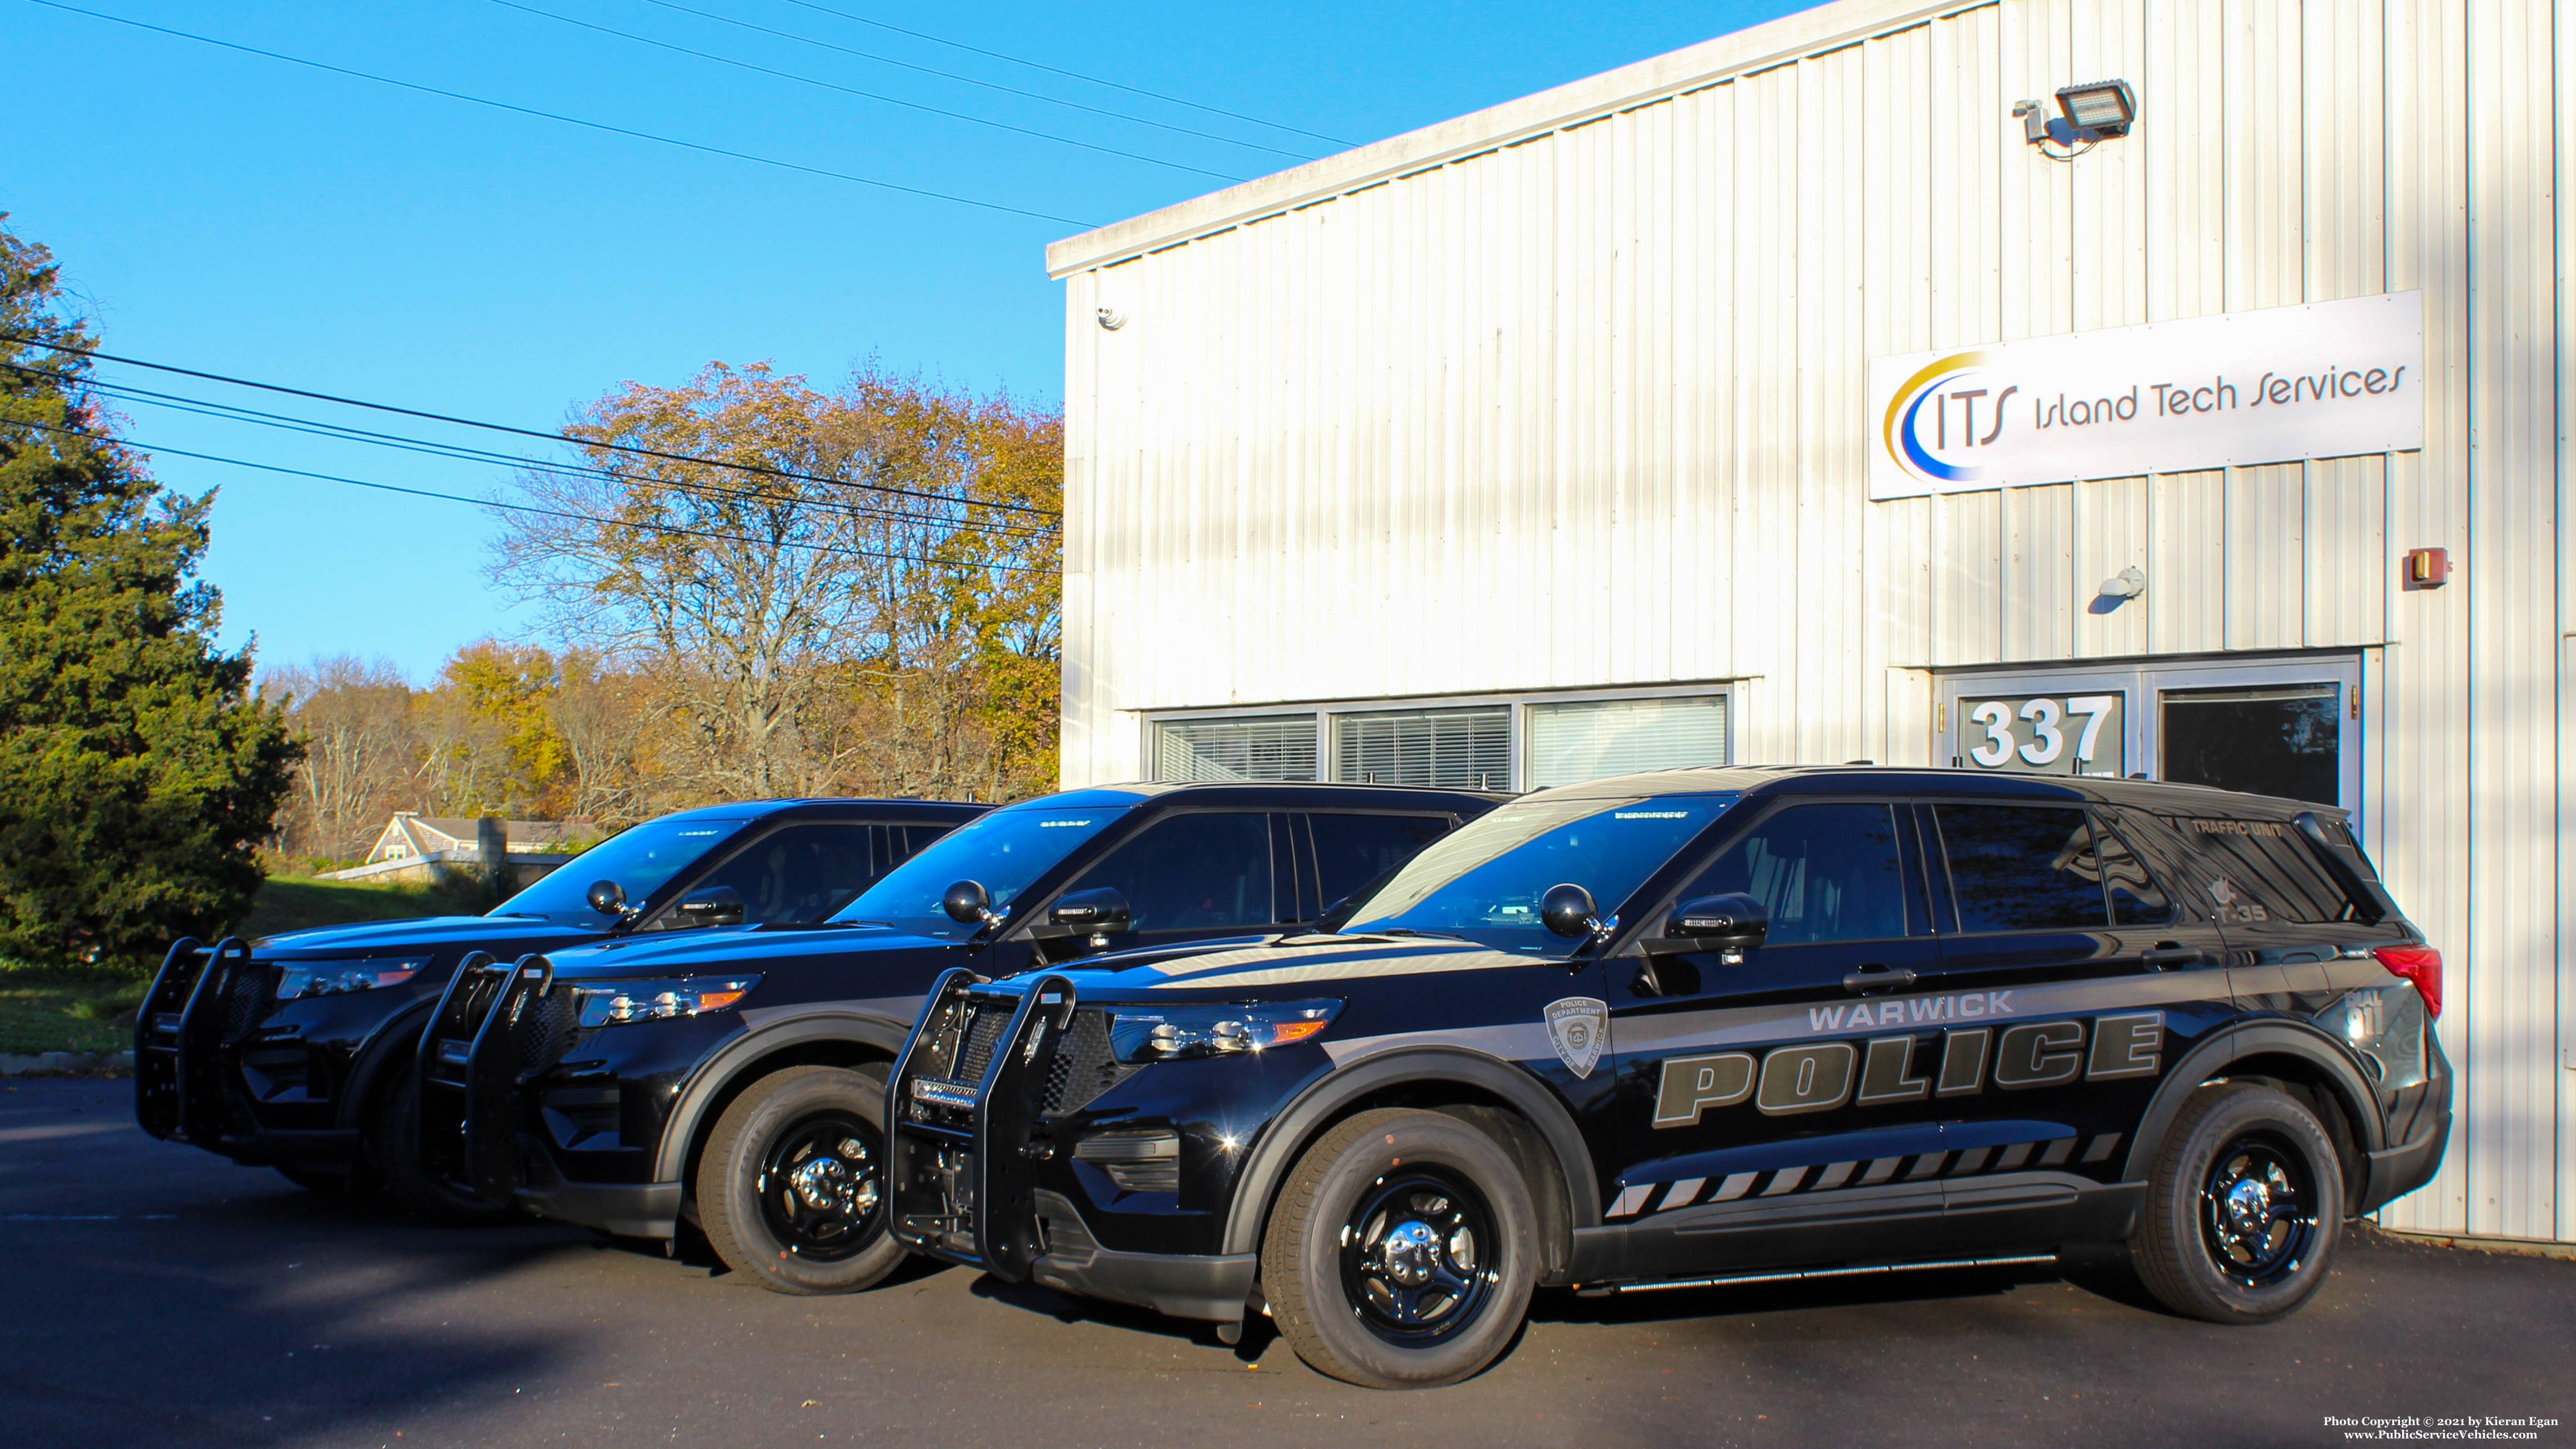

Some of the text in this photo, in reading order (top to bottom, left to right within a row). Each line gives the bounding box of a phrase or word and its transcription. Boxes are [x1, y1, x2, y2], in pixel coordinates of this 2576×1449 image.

[2036, 365, 2406, 429] Island Tech Services
[1938, 385, 2017, 450] ITS
[1971, 696, 2112, 767] 337
[2192, 820, 2283, 837] TRAFFIC UNIT
[2216, 905, 2267, 923] T-35
[1552, 1008, 1600, 1019] DEPARTMENT
[1808, 990, 2014, 1031] WARWICK
[2344, 990, 2383, 1007] DIAL
[1552, 1036, 1575, 1067] CITY OF
[1586, 1027, 1604, 1067] WARWICK
[1651, 1010, 2165, 1129] POLICE
